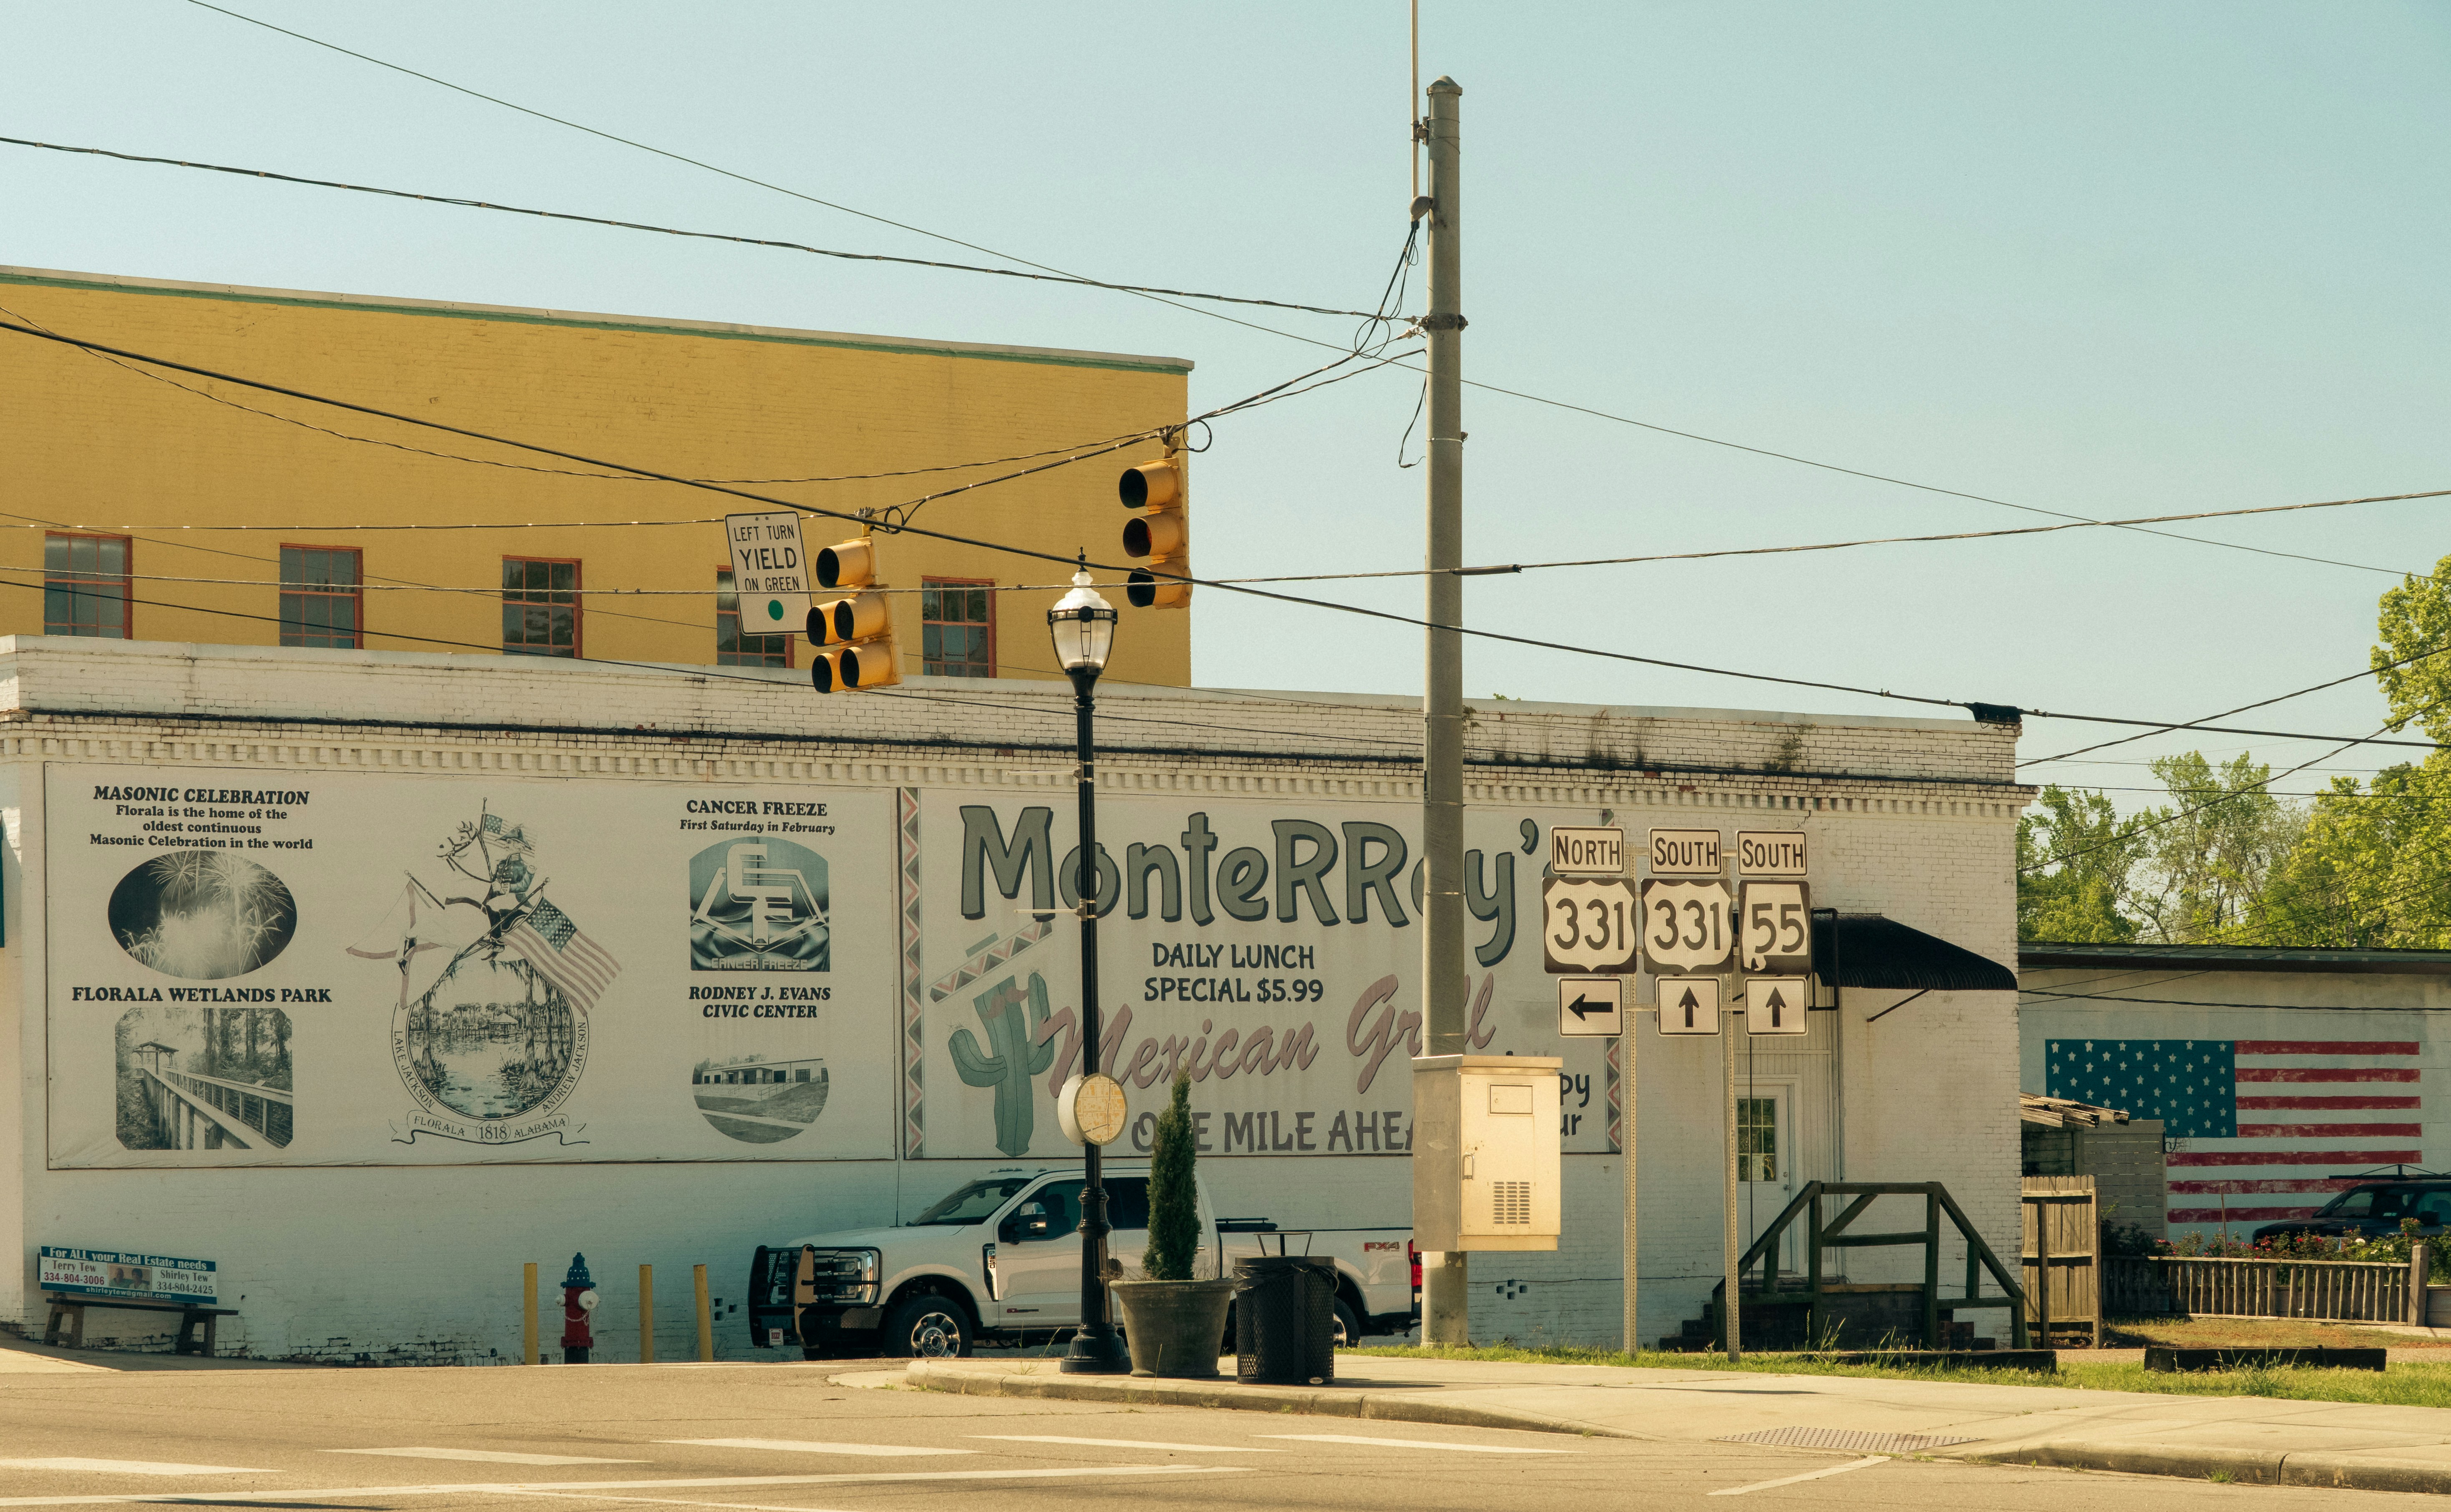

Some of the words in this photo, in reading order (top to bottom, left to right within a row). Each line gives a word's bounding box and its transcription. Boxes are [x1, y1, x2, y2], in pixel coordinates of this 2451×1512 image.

[734, 526, 759, 541] LEFT
[766, 525, 794, 540] TURN
[739, 548, 796, 570] YIELD
[745, 578, 759, 591] ON
[765, 576, 800, 591] GREEN
[93, 786, 179, 801] MASONIC
[184, 789, 310, 804] CELEBRATION
[116, 805, 164, 816] Florala
[169, 806, 179, 816] is
[183, 807, 205, 817] the
[209, 808, 244, 818] home
[249, 809, 262, 819] of
[266, 809, 287, 819] the
[687, 800, 757, 814] CANCER
[763, 802, 827, 816] FREEZE
[143, 821, 183, 831] oldest
[188, 823, 261, 833] continuous
[680, 819, 707, 830] First
[711, 820, 764, 833] Saturday
[768, 821, 778, 831] in
[782, 822, 835, 835] February
[91, 834, 144, 845] Masonic
[148, 836, 226, 847] Celebration
[230, 838, 243, 848] in
[247, 838, 269, 848] the
[272, 839, 312, 849] world
[1556, 836, 1620, 865] NORTH
[1655, 837, 1717, 866] SOUTH
[1742, 839, 1803, 867] SOUTH
[1554, 898, 1624, 950] 331
[1654, 899, 1720, 950] 331
[1752, 903, 1804, 954] 55
[711, 958, 759, 969] CANCER
[762, 959, 808, 969] FREEZE
[1153, 943, 1223, 968] DAILY
[1231, 944, 1314, 969] LUNCH
[72, 987, 163, 1001] FLORALA
[169, 988, 275, 1002] WETLANDS
[281, 989, 332, 1002] PARK
[689, 987, 757, 1000] RODNEY
[761, 987, 774, 1000] J.
[779, 987, 830, 1000] EVANS
[1145, 977, 1250, 1002] SPECIAL
[1257, 977, 1323, 1004] $5.99
[703, 1005, 749, 1017] CIVIC
[754, 1005, 817, 1018] CENTER
[1037, 1002, 1319, 1099] Mexican
[394, 1031, 406, 1061] LAKE
[401, 1065, 435, 1108] JACKSON
[542, 1072, 576, 1112] ANDREW
[572, 1022, 586, 1071] JACKSON
[414, 1116, 465, 1136] FLORALA
[479, 1124, 507, 1139] 1818
[514, 1118, 566, 1138] ALABAMA
[1132, 1111, 1213, 1153] OE
[1224, 1110, 1317, 1153] MILE
[1364, 1242, 1399, 1252] FX4
[50, 1248, 67, 1257] For
[70, 1249, 89, 1260] ALL
[92, 1253, 116, 1262] your
[119, 1253, 141, 1264] Real
[144, 1256, 174, 1267] Estate
[178, 1261, 206, 1270] needs
[53, 1260, 76, 1272] Terry
[80, 1262, 96, 1272] Tew
[44, 1272, 104, 1285] 334-804-3006
[161, 1269, 189, 1282] Shirley
[193, 1272, 209, 1282] Tew
[86, 1287, 171, 1299] shirleytew@gmail.com
[157, 1281, 213, 1294] 334-804-2425
